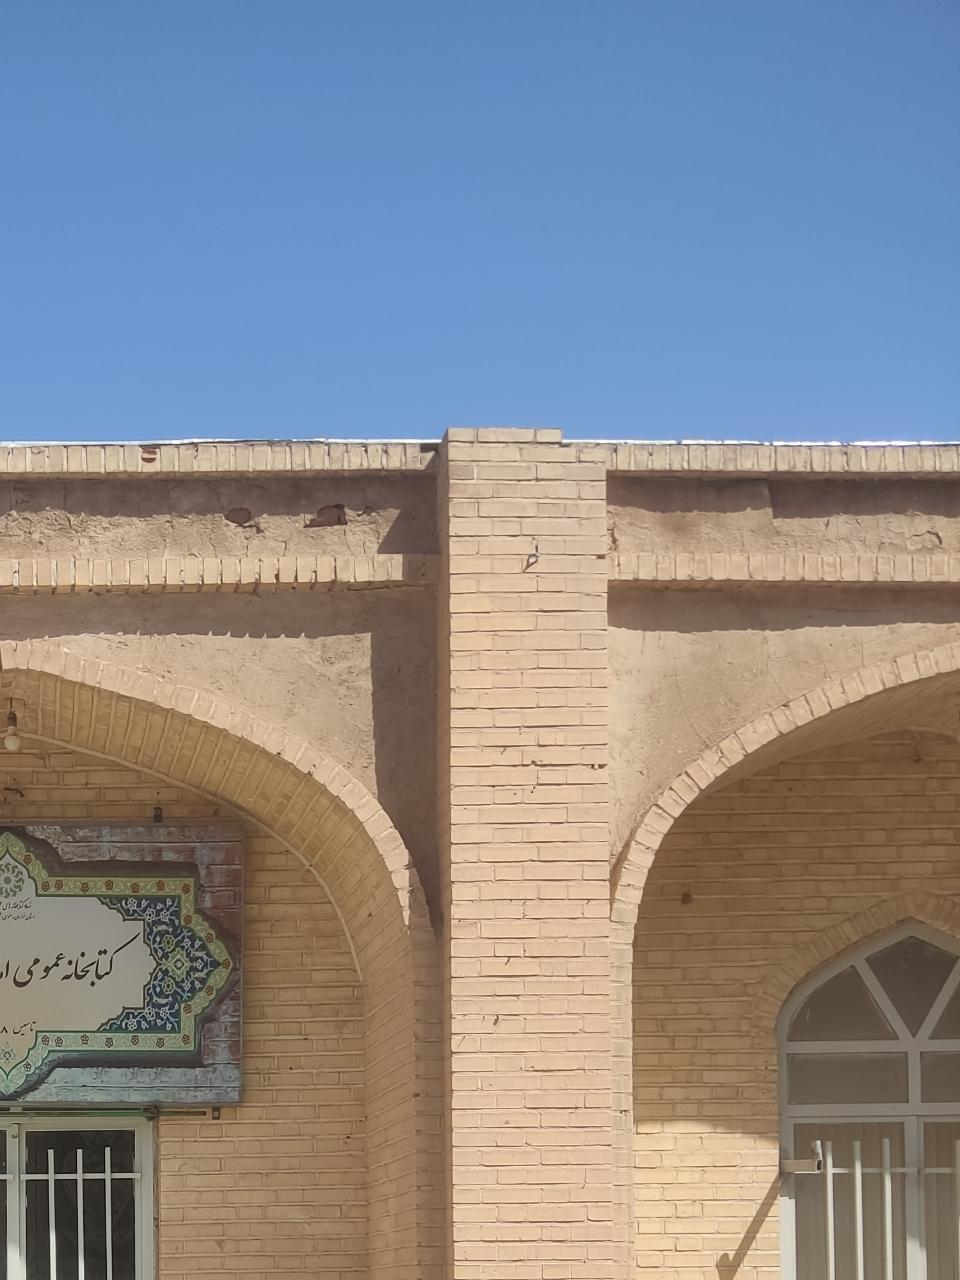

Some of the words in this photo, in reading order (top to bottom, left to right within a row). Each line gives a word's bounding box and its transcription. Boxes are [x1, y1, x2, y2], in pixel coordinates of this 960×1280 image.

[13, 952, 66, 988] عمومی
[61, 931, 141, 988] کتابخانه
[12, 1021, 37, 1036] تاسیس
